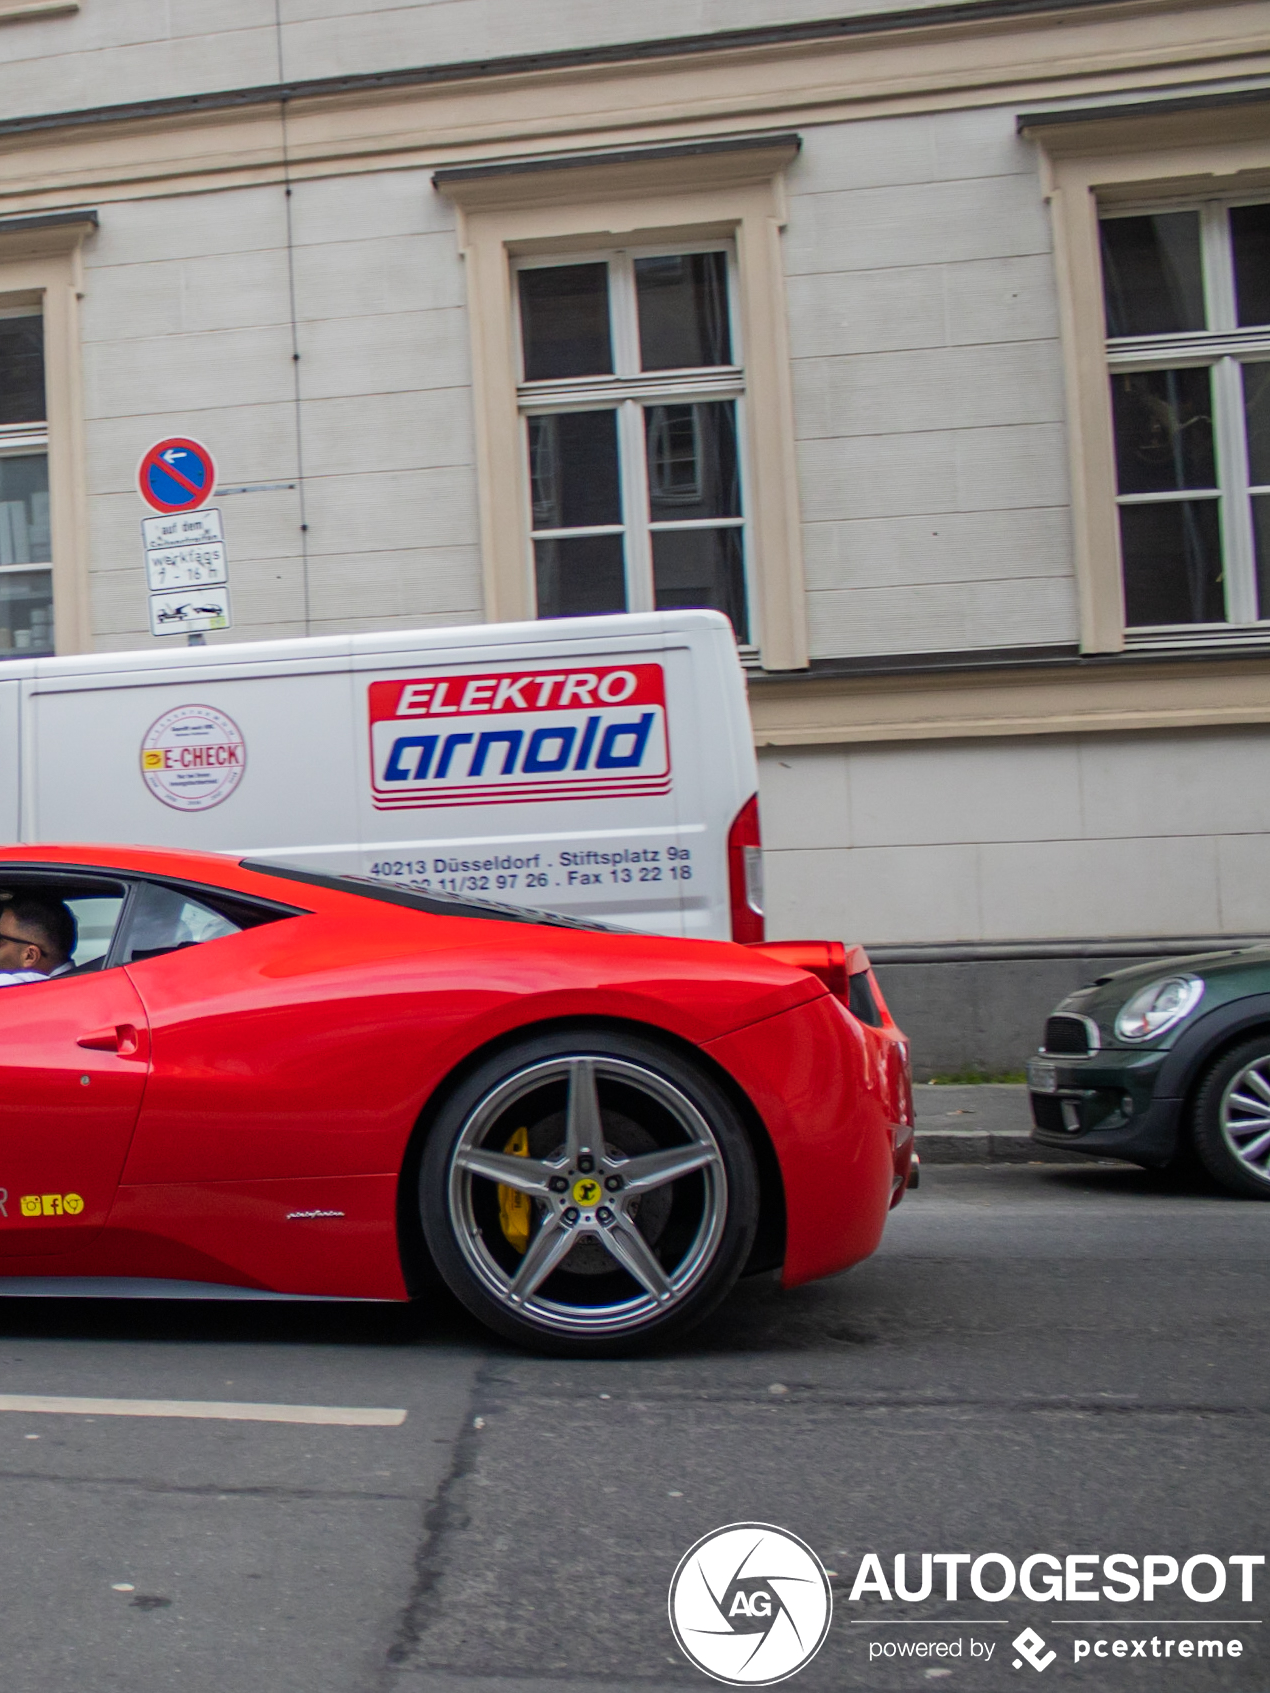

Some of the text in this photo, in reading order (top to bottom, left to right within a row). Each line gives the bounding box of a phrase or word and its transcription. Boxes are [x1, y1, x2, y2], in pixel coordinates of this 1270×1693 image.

[162, 521, 202, 535] auf dem
[396, 670, 637, 716] ELEKTRO
[164, 745, 240, 768] E-CHECK
[383, 712, 656, 781] arnold
[371, 846, 690, 876] 40213 Düsseldorf Stiftsplatz 9a
[495, 874, 518, 890] 97
[525, 873, 549, 888] 26
[567, 870, 603, 885] Fax
[610, 868, 632, 883] 13
[638, 867, 662, 882] 22
[669, 865, 692, 880] 18
